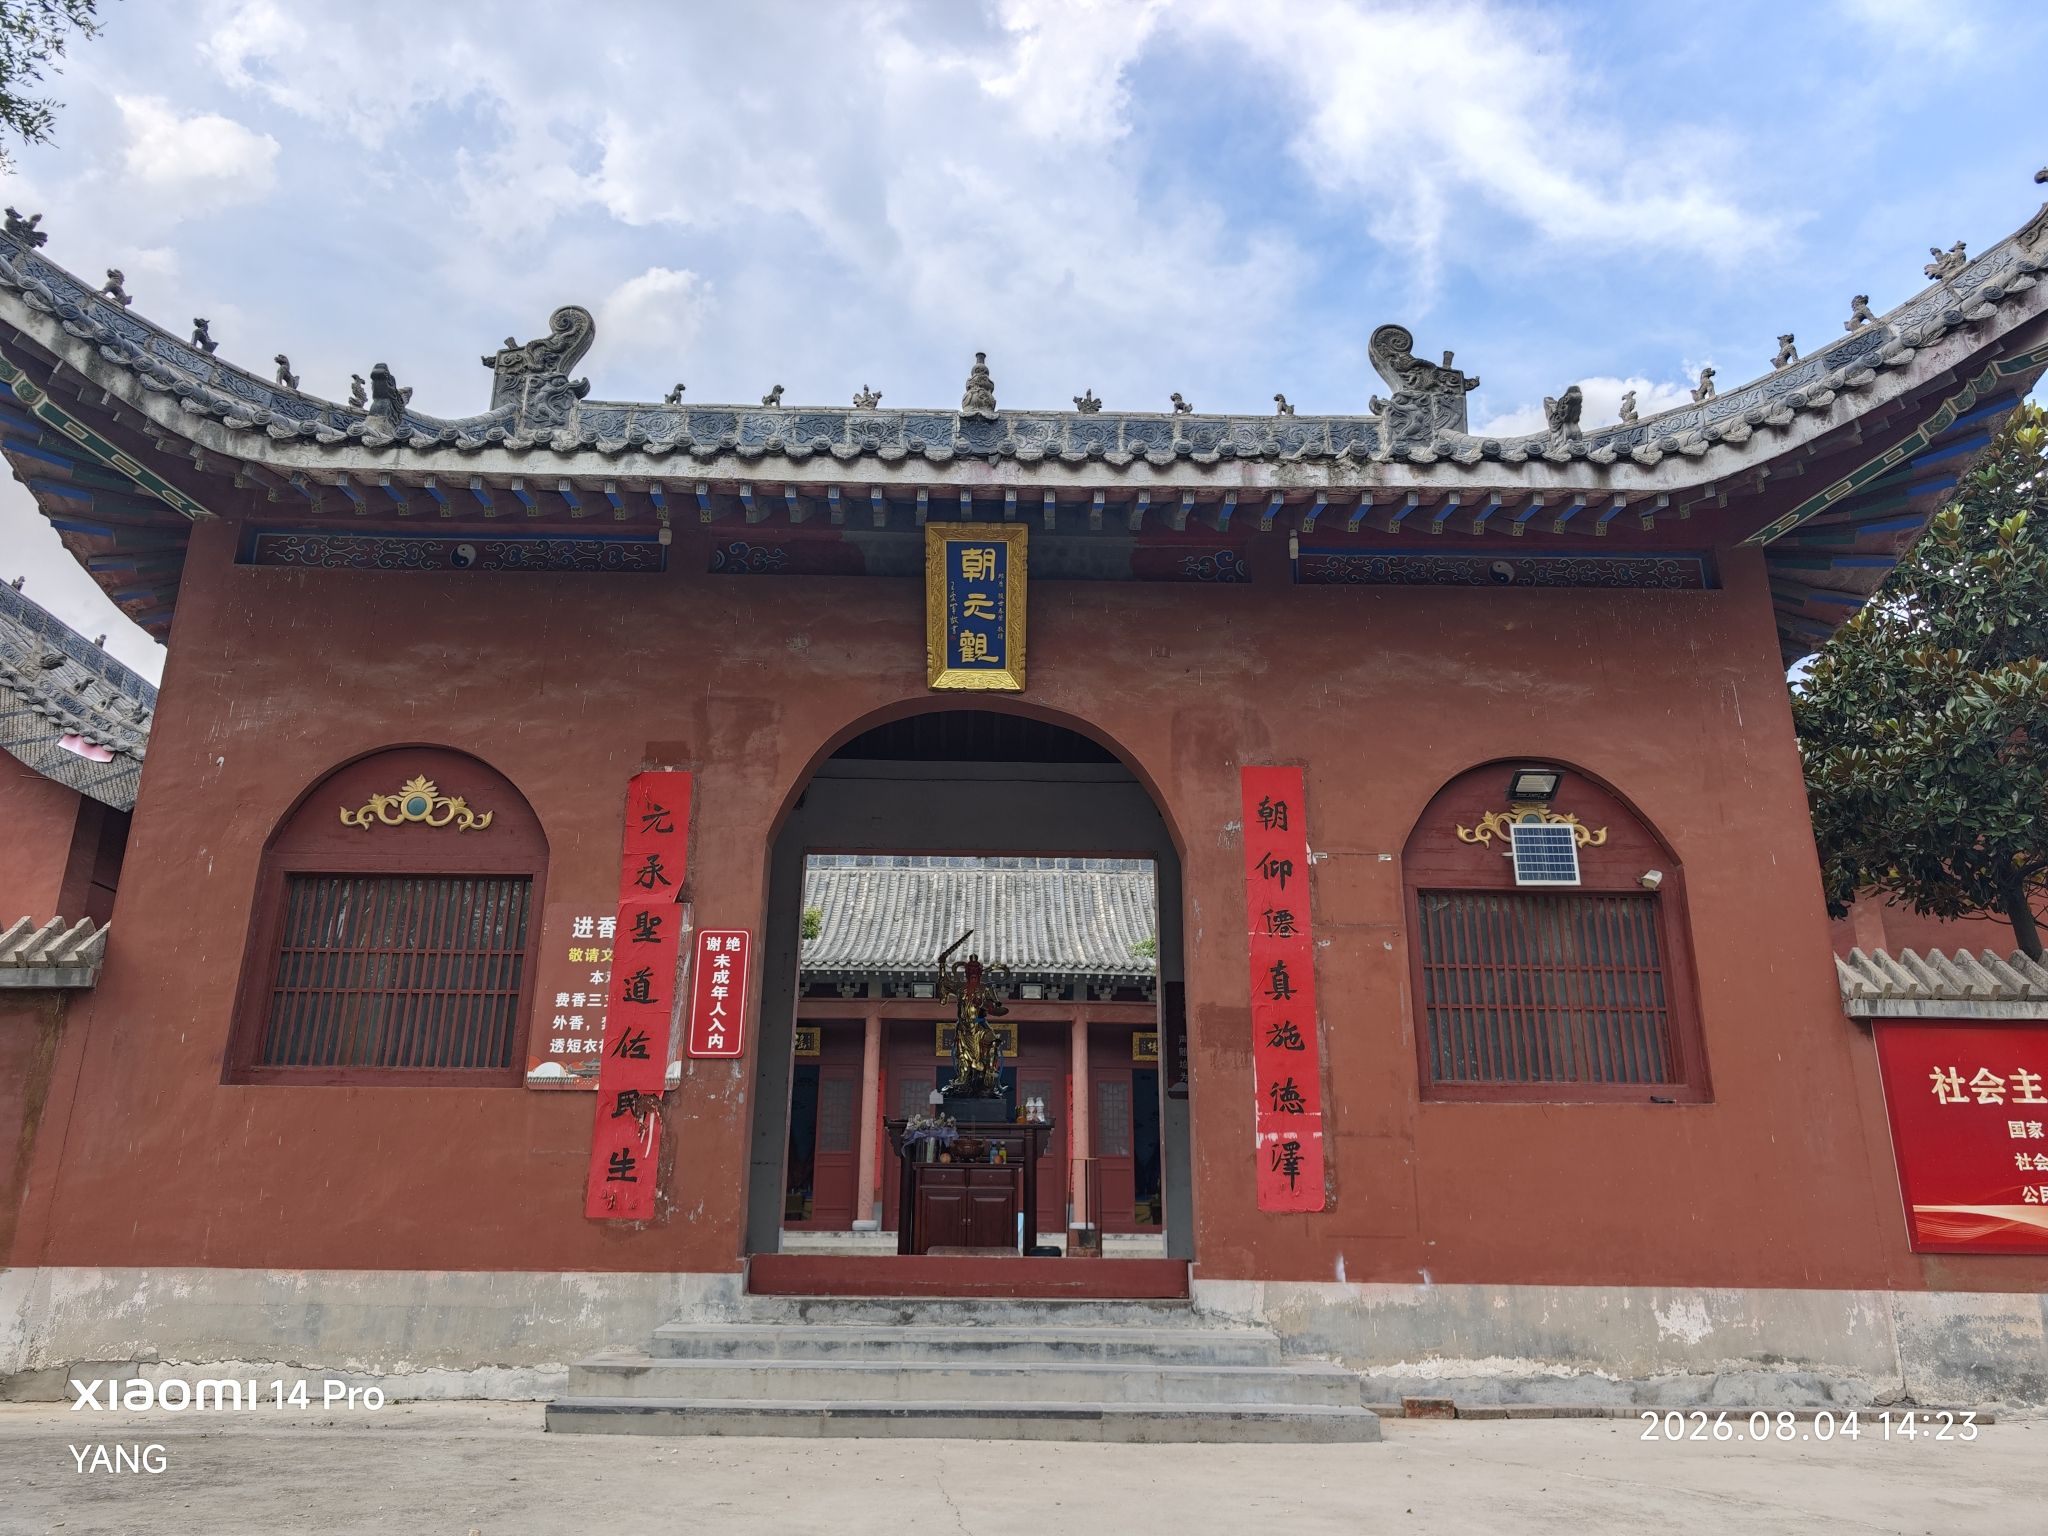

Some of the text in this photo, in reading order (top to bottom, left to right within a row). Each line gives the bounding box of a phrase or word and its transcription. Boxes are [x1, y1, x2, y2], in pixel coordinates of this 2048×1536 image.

[959, 548, 999, 663] 朝元觀
[572, 916, 616, 939] 进香
[706, 937, 741, 951] 谢绝
[568, 947, 613, 963] 敬请文
[708, 954, 731, 1049] 未成年人入内
[1928, 1066, 2048, 1105] 社会主
[2007, 1120, 2045, 1139] 国家
[2014, 1152, 2048, 1171] 社会
